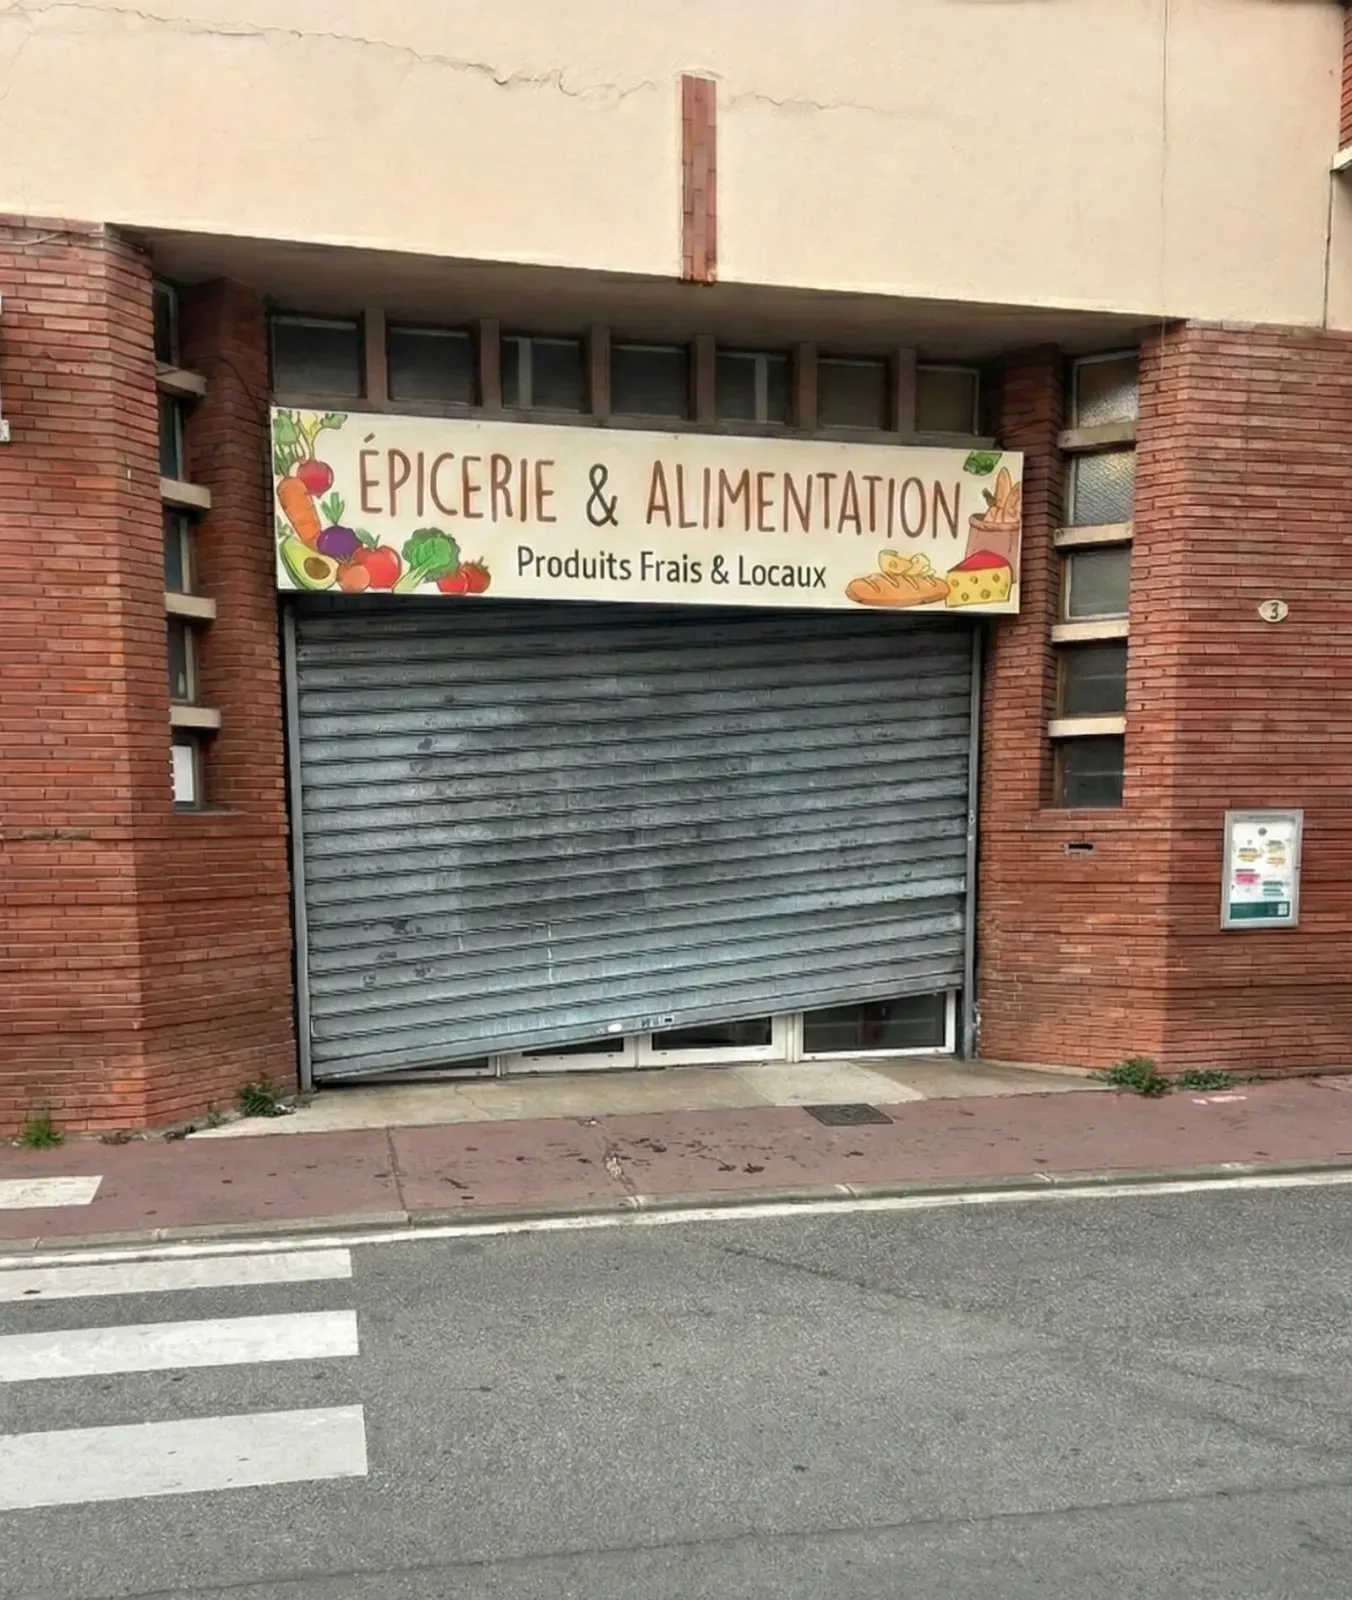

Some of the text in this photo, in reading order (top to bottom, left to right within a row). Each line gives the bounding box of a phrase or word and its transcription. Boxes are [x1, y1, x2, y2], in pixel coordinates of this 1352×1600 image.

[358, 432, 961, 540] ÉPICERIE & ALIMENTATION
[517, 545, 827, 589] Produits Frais & Locaux
[1270, 601, 1279, 620] 3
